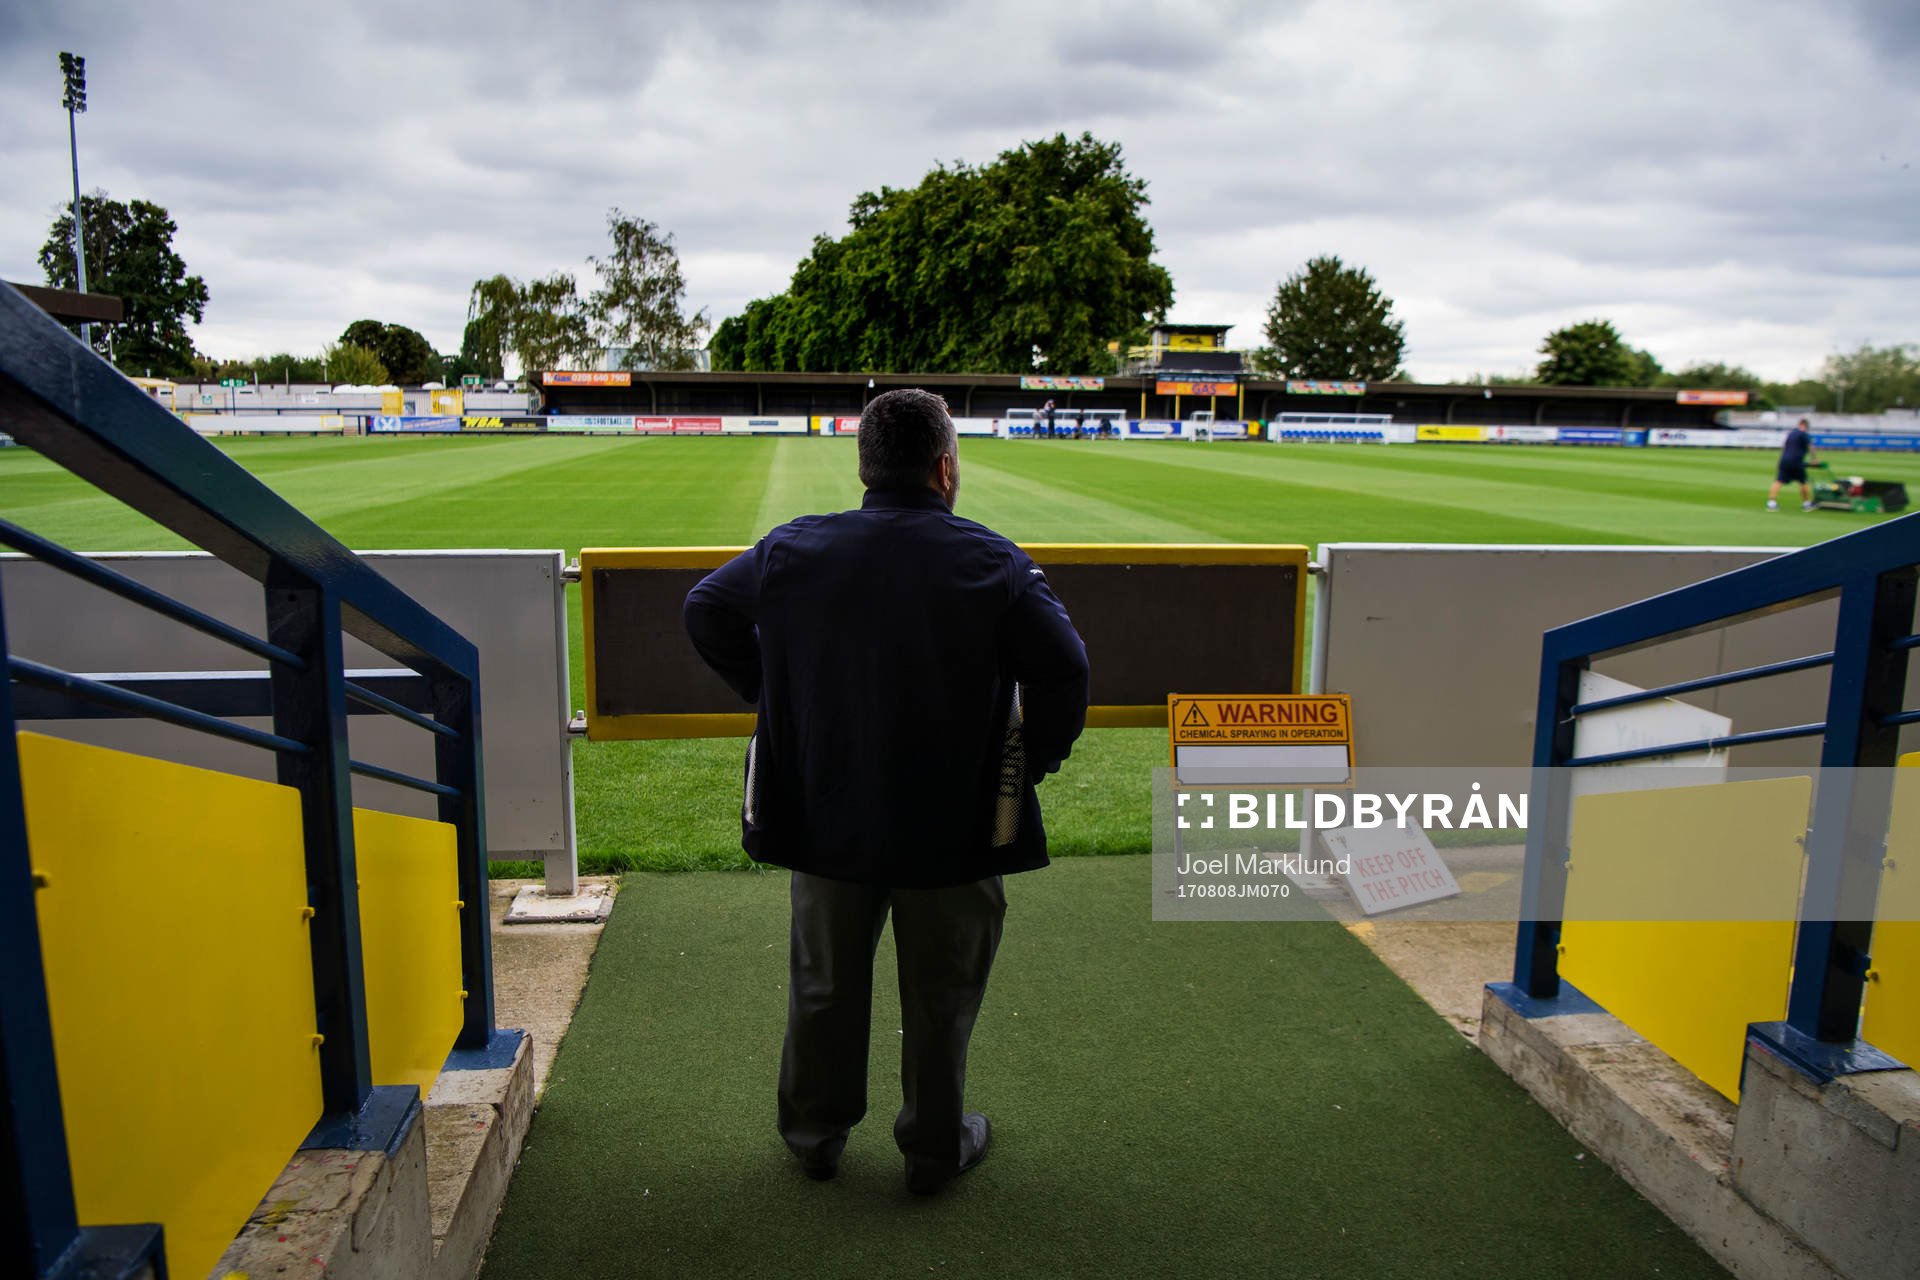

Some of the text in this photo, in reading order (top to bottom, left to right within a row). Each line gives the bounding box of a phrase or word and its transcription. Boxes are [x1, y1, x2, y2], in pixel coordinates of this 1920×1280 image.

[1217, 703, 1338, 723] WARNING
[1179, 729, 1343, 739] CHEMICAL SPRAYING IN OPERATION
[1354, 847, 1427, 879] KEEP OFF
[1362, 868, 1446, 903] THE PITCH
